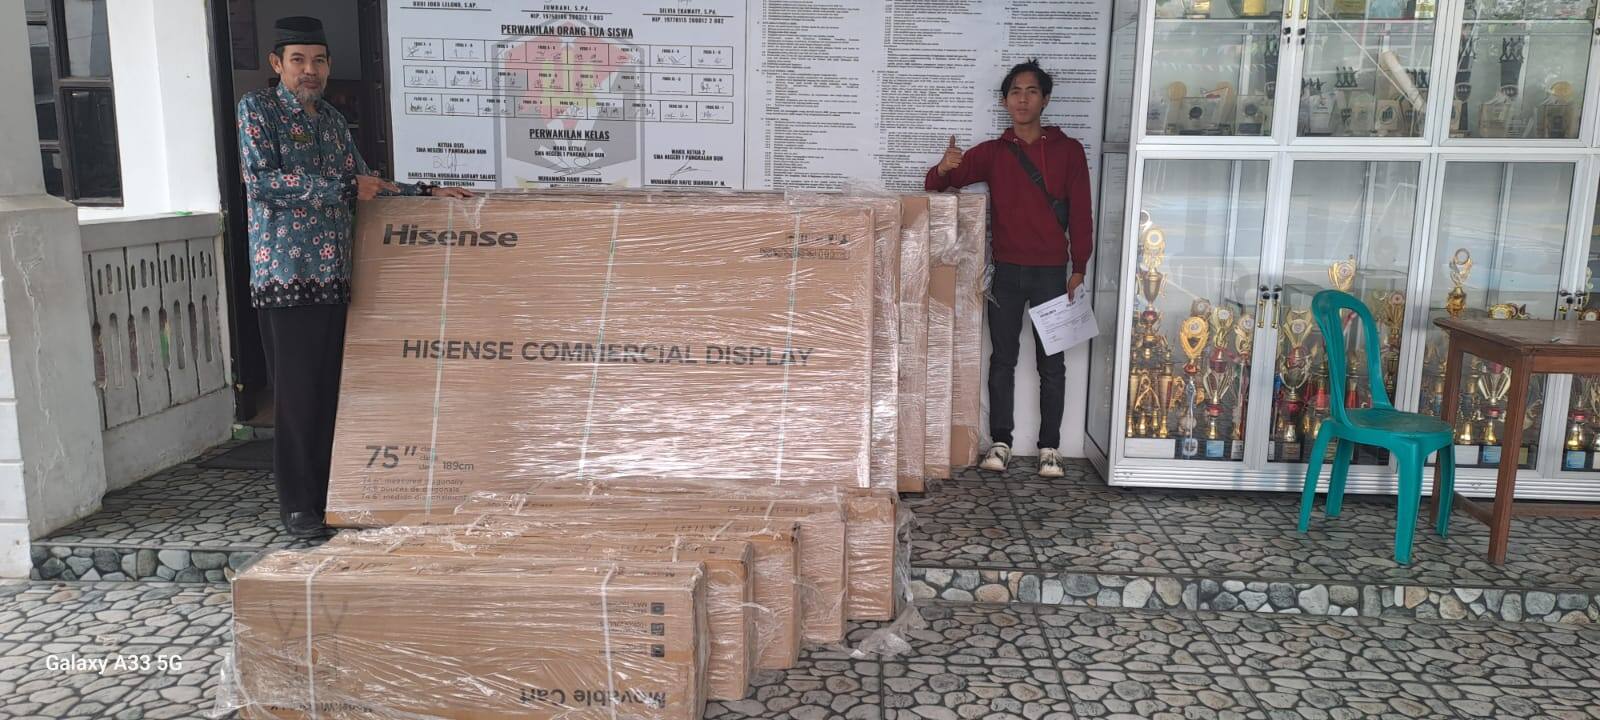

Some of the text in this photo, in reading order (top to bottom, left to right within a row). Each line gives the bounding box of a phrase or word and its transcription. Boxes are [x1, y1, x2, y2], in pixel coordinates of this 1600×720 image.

[501, 24, 634, 38] PERWAKILAN ORANG TUA SISWA
[529, 128, 610, 140] PERWAKILAN KELAS
[383, 223, 518, 248] Hisense
[402, 339, 814, 366] HISENSE COMMERCIAL DISPLAY
[442, 461, 474, 471] 189cm
[519, 688, 666, 709] Movable Cart
